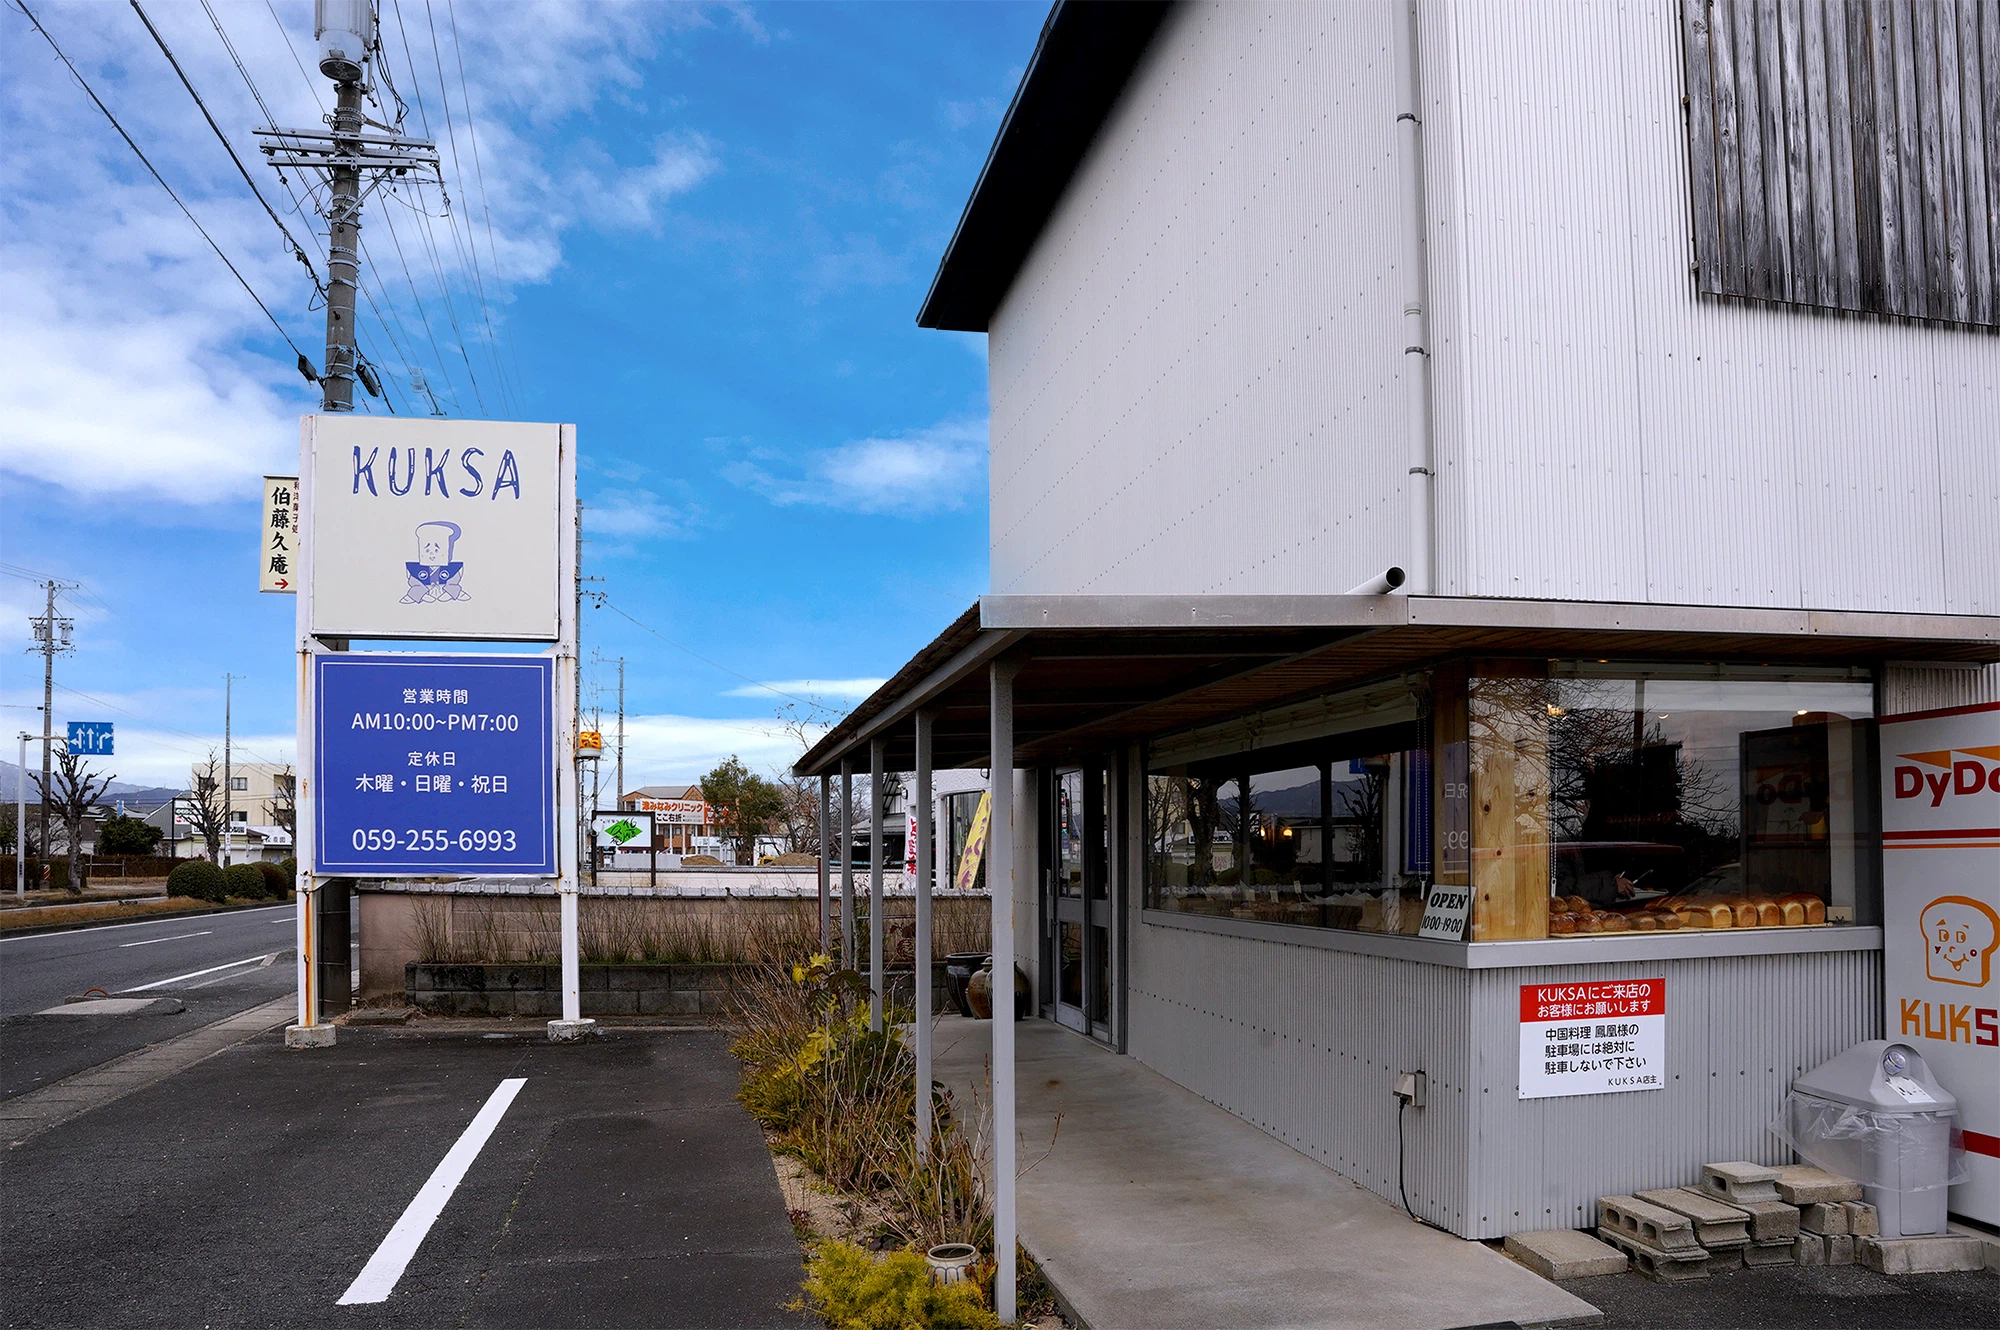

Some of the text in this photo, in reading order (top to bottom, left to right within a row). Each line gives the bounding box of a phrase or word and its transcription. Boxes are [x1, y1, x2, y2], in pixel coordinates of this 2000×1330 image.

[353, 445, 520, 500] KUKSA
[268, 486, 291, 575] 伯藤久庵
[402, 688, 468, 704] 営業時間
[407, 751, 456, 766] 定休日
[355, 773, 508, 793] 木曜・日曜・祝日
[641, 801, 703, 812] 津みなみクリニック
[656, 813, 682, 823] ここ右折
[352, 829, 517, 851] 059-255-6993
[1430, 892, 1468, 910] OPEN
[1537, 983, 1650, 1002] KUKSAにご来店の
[1537, 999, 1651, 1018] お客様にお願いします
[1545, 1023, 1639, 1041] 中国料理 鳳凰様の
[1545, 1040, 1635, 1058] 駐車場には絶対に
[1545, 1056, 1647, 1075] 駐車しないで下さい
